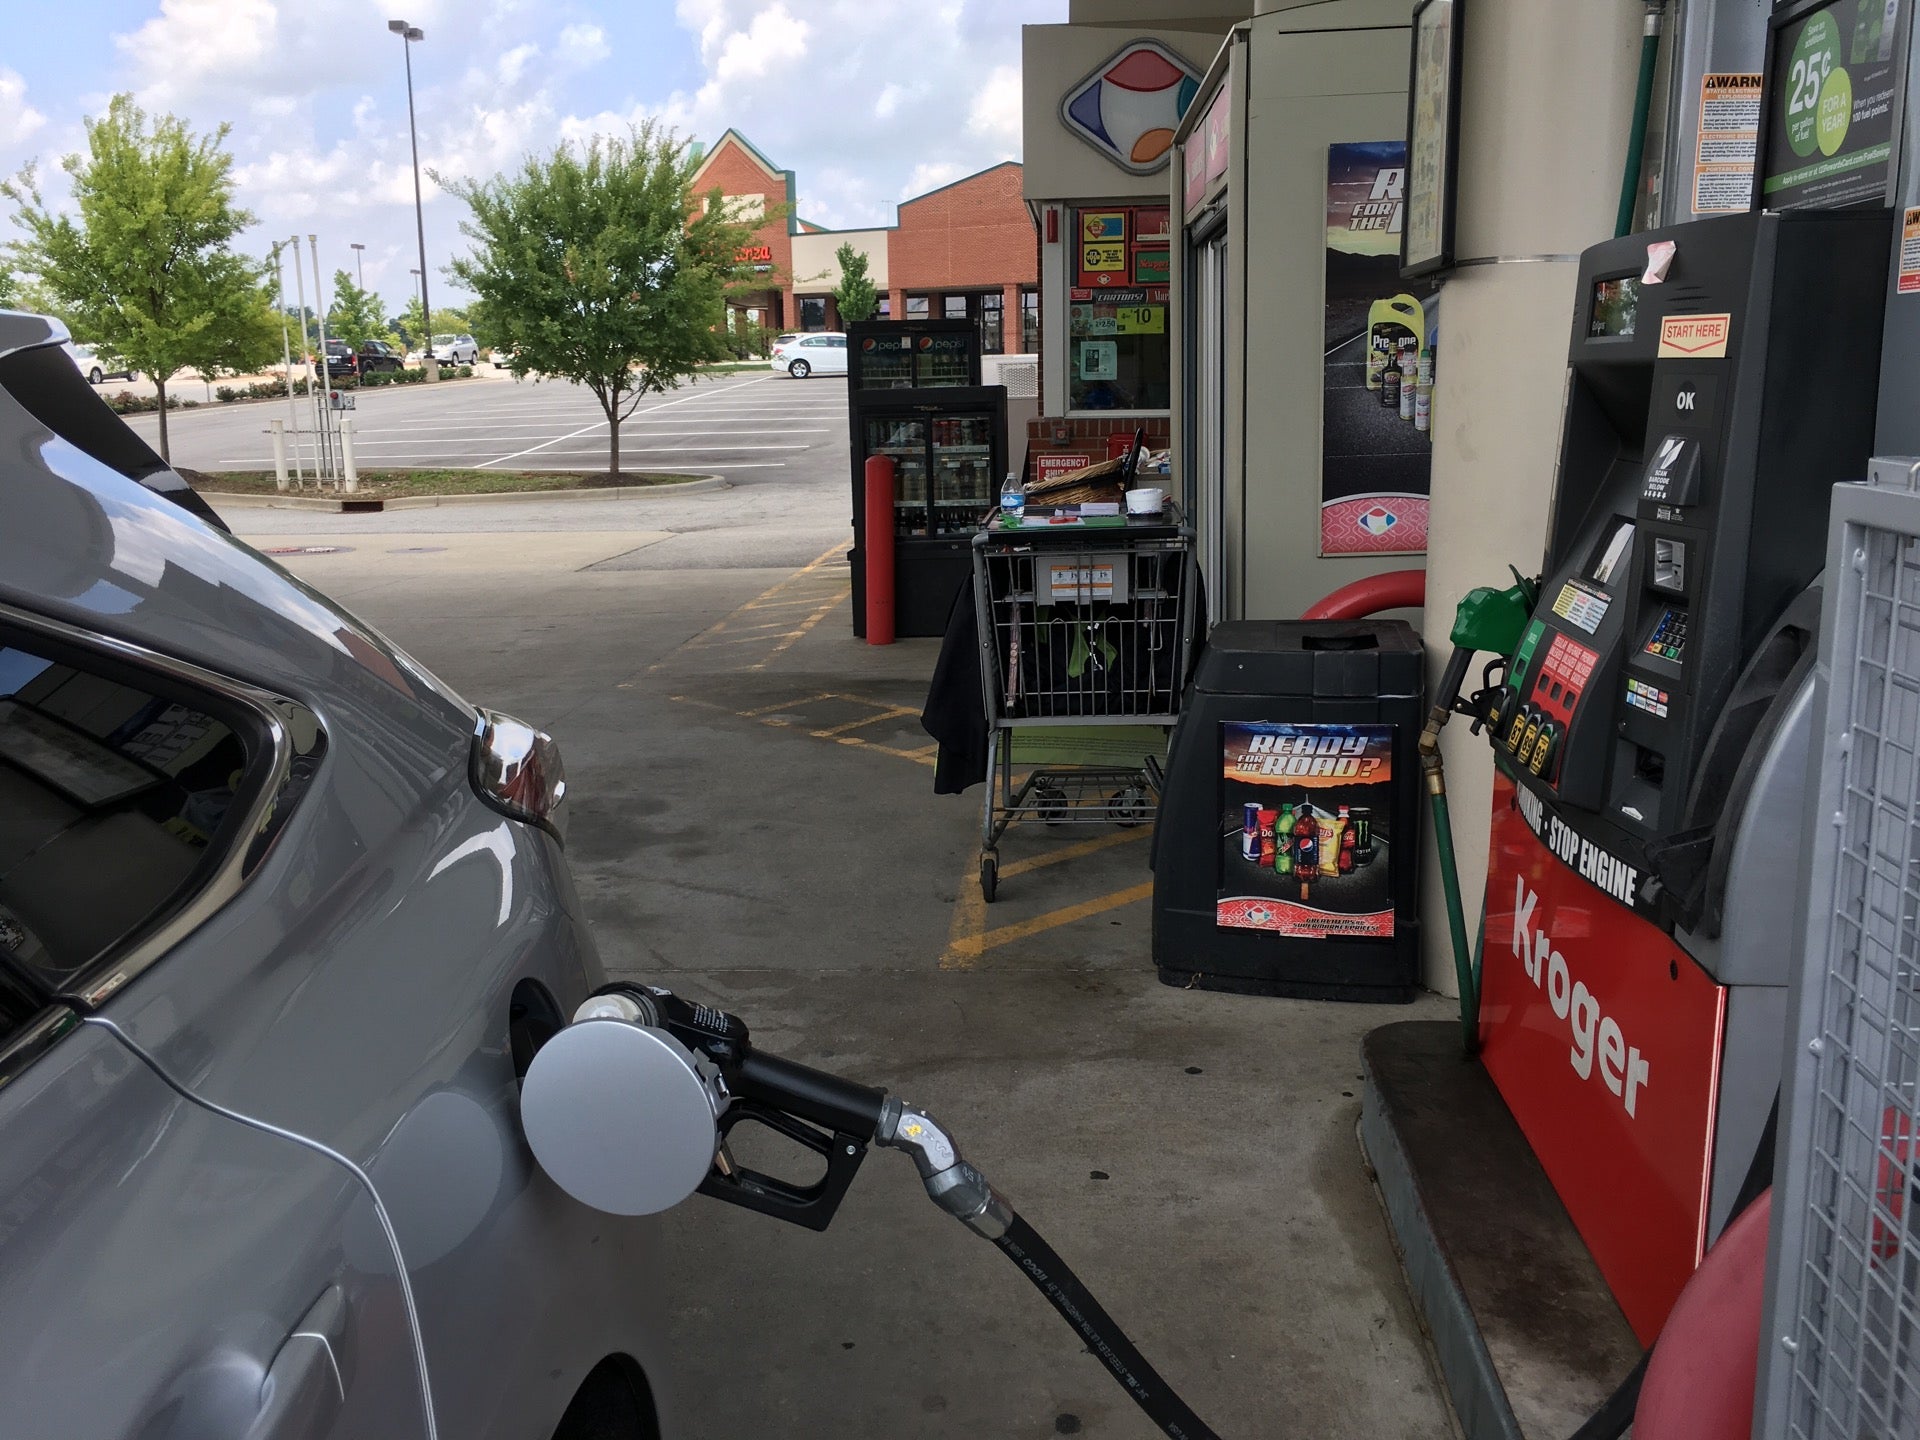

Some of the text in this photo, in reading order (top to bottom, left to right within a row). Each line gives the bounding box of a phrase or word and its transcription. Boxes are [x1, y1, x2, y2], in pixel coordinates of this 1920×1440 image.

[1823, 92, 1847, 115] FOR A
[1822, 112, 1846, 133] YEAR!
[1352, 202, 1392, 216] FOR
[1350, 216, 1388, 231] THE
[1667, 324, 1722, 339] START HERE
[935, 340, 965, 350] pepsi
[1373, 334, 1417, 348] Preone
[1676, 392, 1696, 410] OK
[1040, 459, 1086, 468] EMERGENCY
[1648, 476, 1670, 484] BARCODE
[1510, 725, 1522, 744] 87
[1248, 734, 1369, 756] READY
[1522, 735, 1533, 754] 89
[1237, 754, 1264, 764] FOR
[1534, 746, 1545, 766] 93
[1236, 762, 1262, 772] THE
[1260, 755, 1382, 778] ROAD?
[1549, 816, 1580, 866] STOP
[1579, 838, 1638, 907] ENGINE
[1512, 874, 1650, 1120] Kroger
